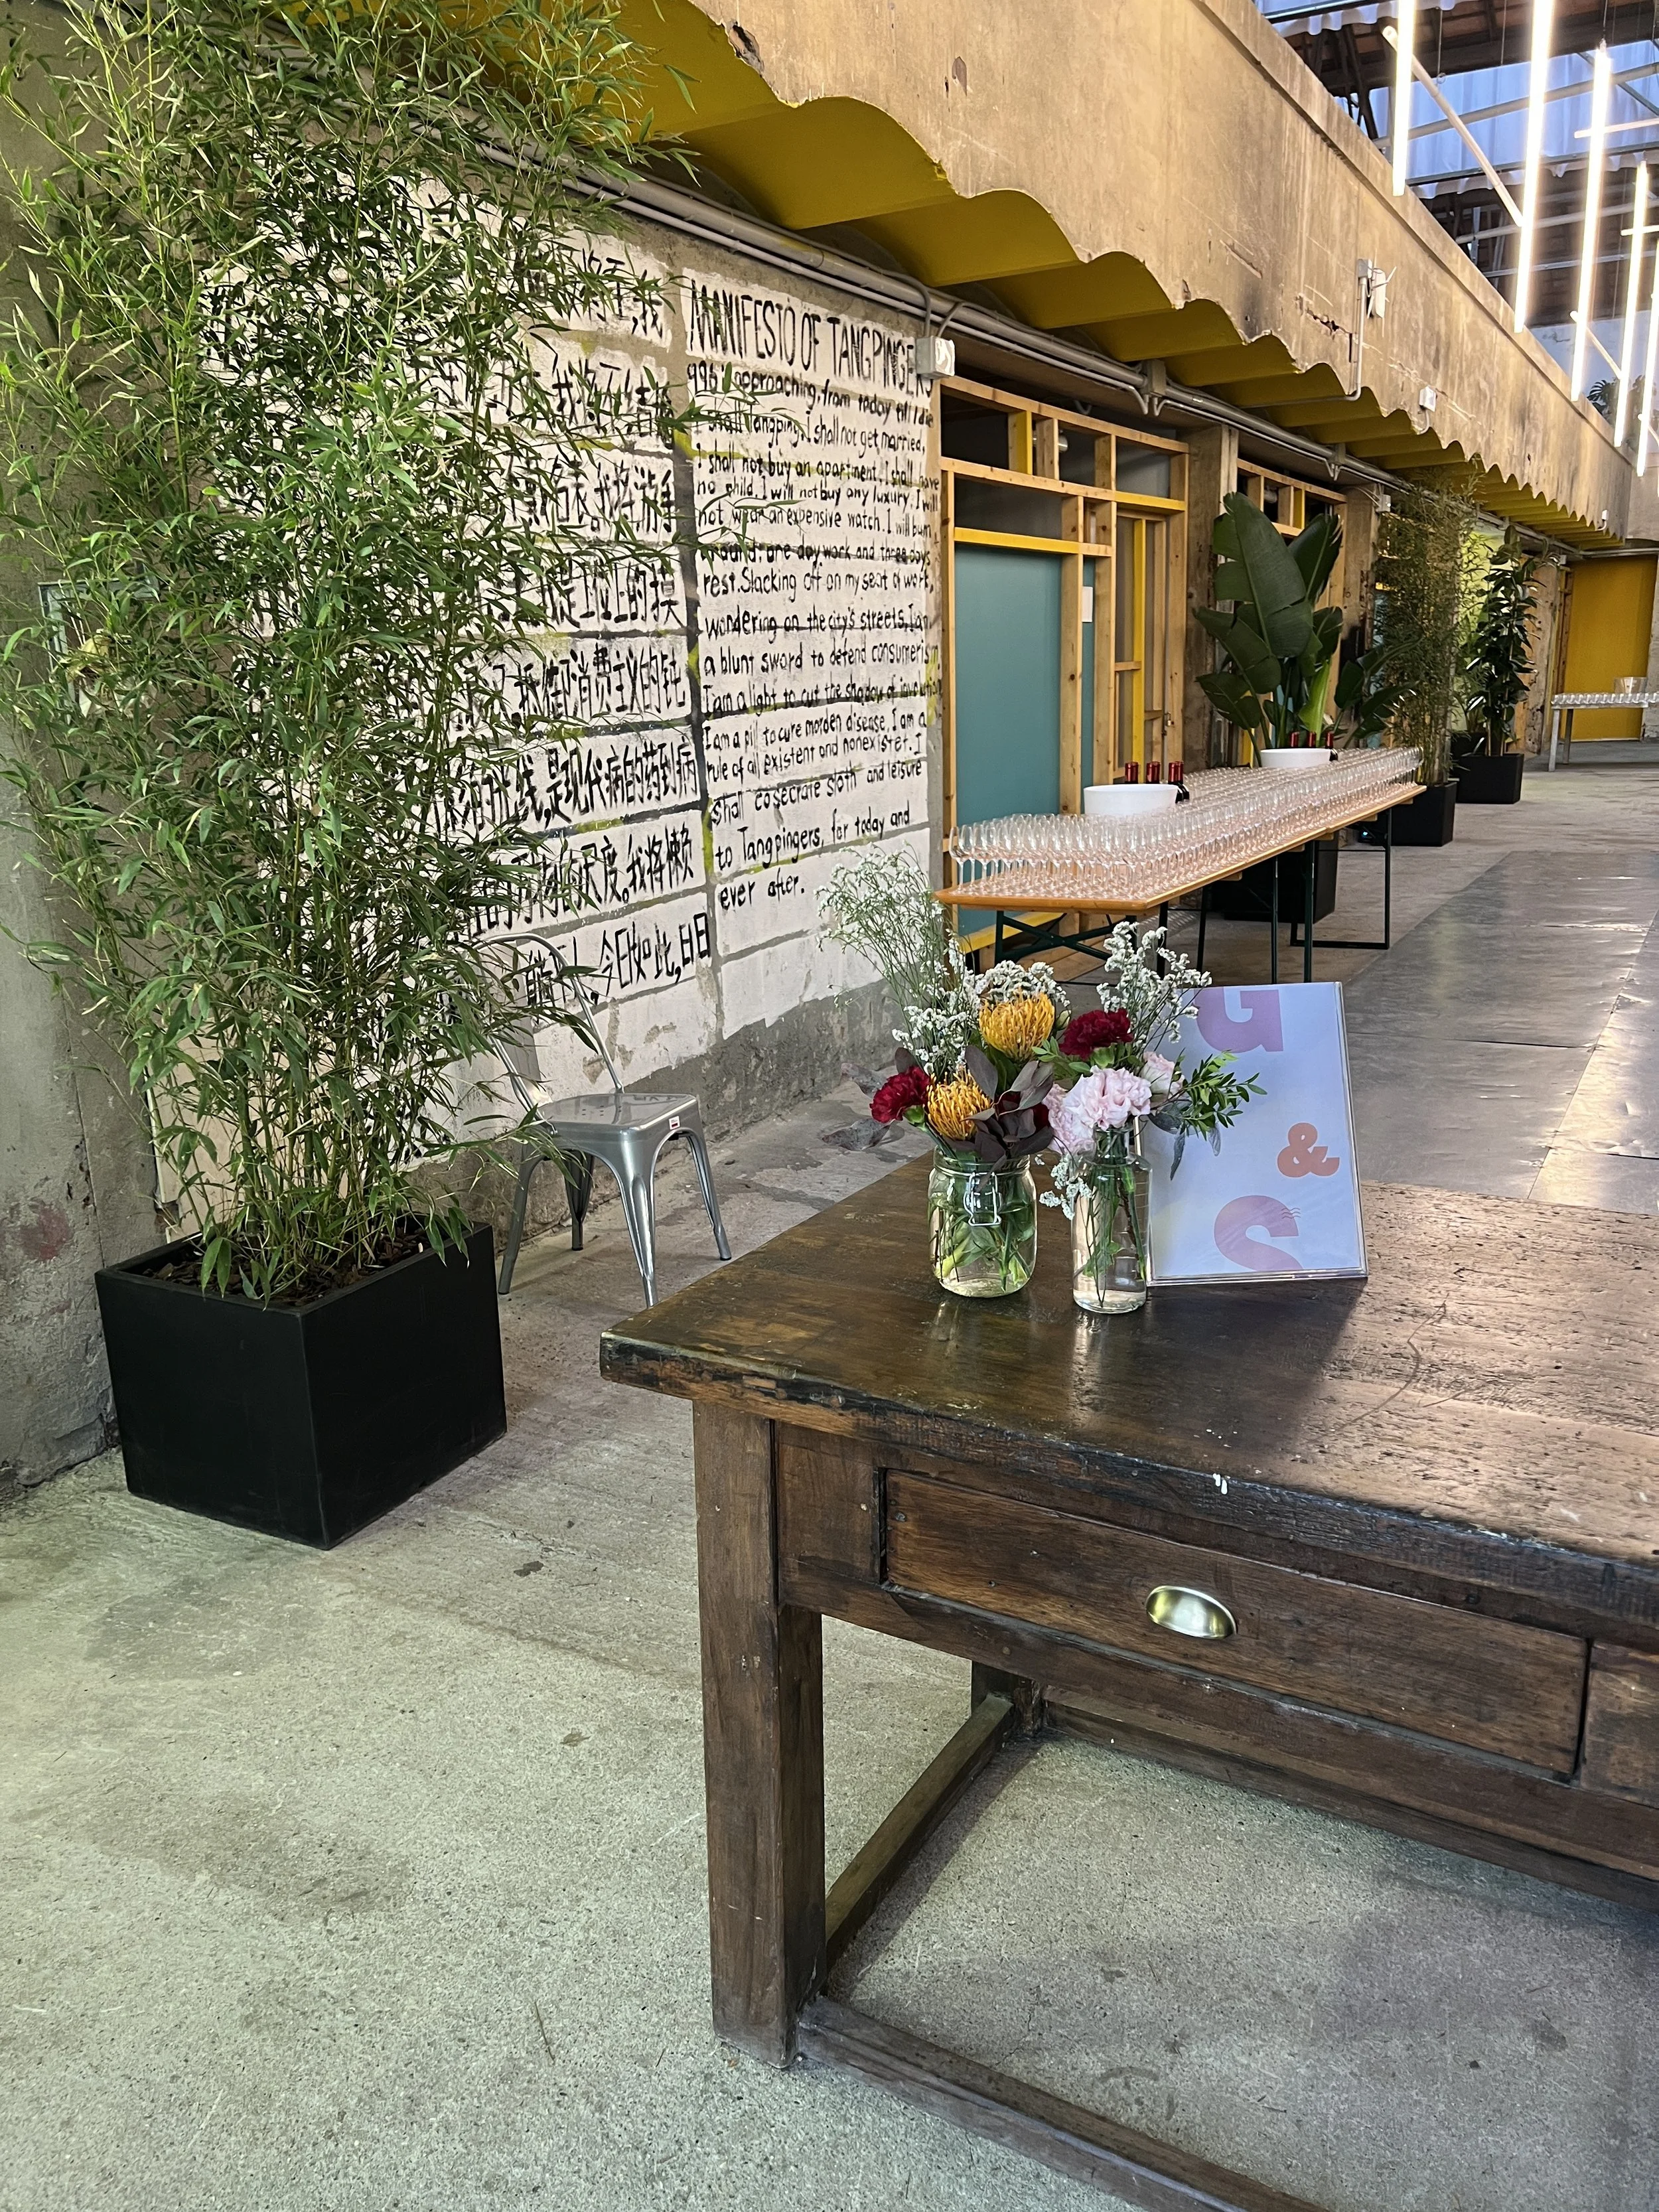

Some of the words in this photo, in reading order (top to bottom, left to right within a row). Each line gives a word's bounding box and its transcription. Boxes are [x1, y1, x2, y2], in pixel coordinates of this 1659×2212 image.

[690, 279, 795, 366] MANIFESTO
[802, 313, 821, 372] OF
[687, 360, 717, 394] 996
[821, 378, 850, 407] from
[858, 394, 891, 425] today
[919, 407, 934, 428] die
[814, 414, 838, 448] shall
[841, 426, 857, 447] not
[860, 429, 879, 459] get
[881, 429, 925, 455] married,
[696, 443, 701, 469] I
[709, 439, 735, 474] shall
[743, 453, 763, 475] not
[768, 451, 791, 487] buy
[796, 460, 810, 477] an
[892, 456, 912, 487] shall
[919, 462, 939, 490] have
[697, 480, 715, 496] no
[771, 483, 794, 500] will
[800, 484, 818, 498] not
[820, 480, 841, 506] buy
[847, 488, 869, 506] any
[922, 494, 938, 513] will
[698, 500, 724, 527] not
[732, 508, 764, 526] war
[770, 508, 784, 524] an
[787, 508, 841, 536] expensive
[896, 513, 910, 537] will
[796, 534, 820, 569] day
[823, 536, 850, 560] work
[857, 538, 875, 559] and
[881, 536, 906, 564] three
[910, 541, 930, 571] days
[804, 561, 822, 592] off
[827, 573, 841, 591] on
[845, 573, 859, 596] my
[863, 569, 887, 591] seat
[784, 615, 800, 632] on
[807, 603, 826, 632] the
[704, 656, 716, 677] a
[721, 645, 755, 676] blunt
[760, 642, 803, 674] sword
[811, 650, 824, 667] to
[830, 634, 866, 668] defend
[737, 691, 747, 710] a
[748, 680, 776, 717] light
[784, 688, 795, 709] to
[802, 684, 820, 707] cut
[825, 671, 841, 703] the
[704, 726, 711, 750] I
[713, 733, 730, 751] am
[733, 731, 741, 748] a
[745, 720, 758, 753] pill
[763, 727, 776, 746] to
[778, 722, 802, 743] cure
[901, 713, 914, 729] am
[919, 712, 927, 728] a
[707, 756, 728, 783] rule
[733, 756, 743, 784] of
[747, 752, 760, 780] all
[764, 747, 815, 775] existent
[819, 735, 837, 758] and
[914, 733, 922, 756] I
[711, 792, 743, 825] shall
[827, 761, 857, 797] sloth
[867, 761, 885, 783] and
[888, 760, 922, 780] leisure
[715, 846, 733, 870] to
[831, 808, 849, 845] for
[855, 806, 885, 840] today
[891, 800, 909, 827] and
[720, 881, 755, 911] ever
[768, 867, 804, 904] after.
